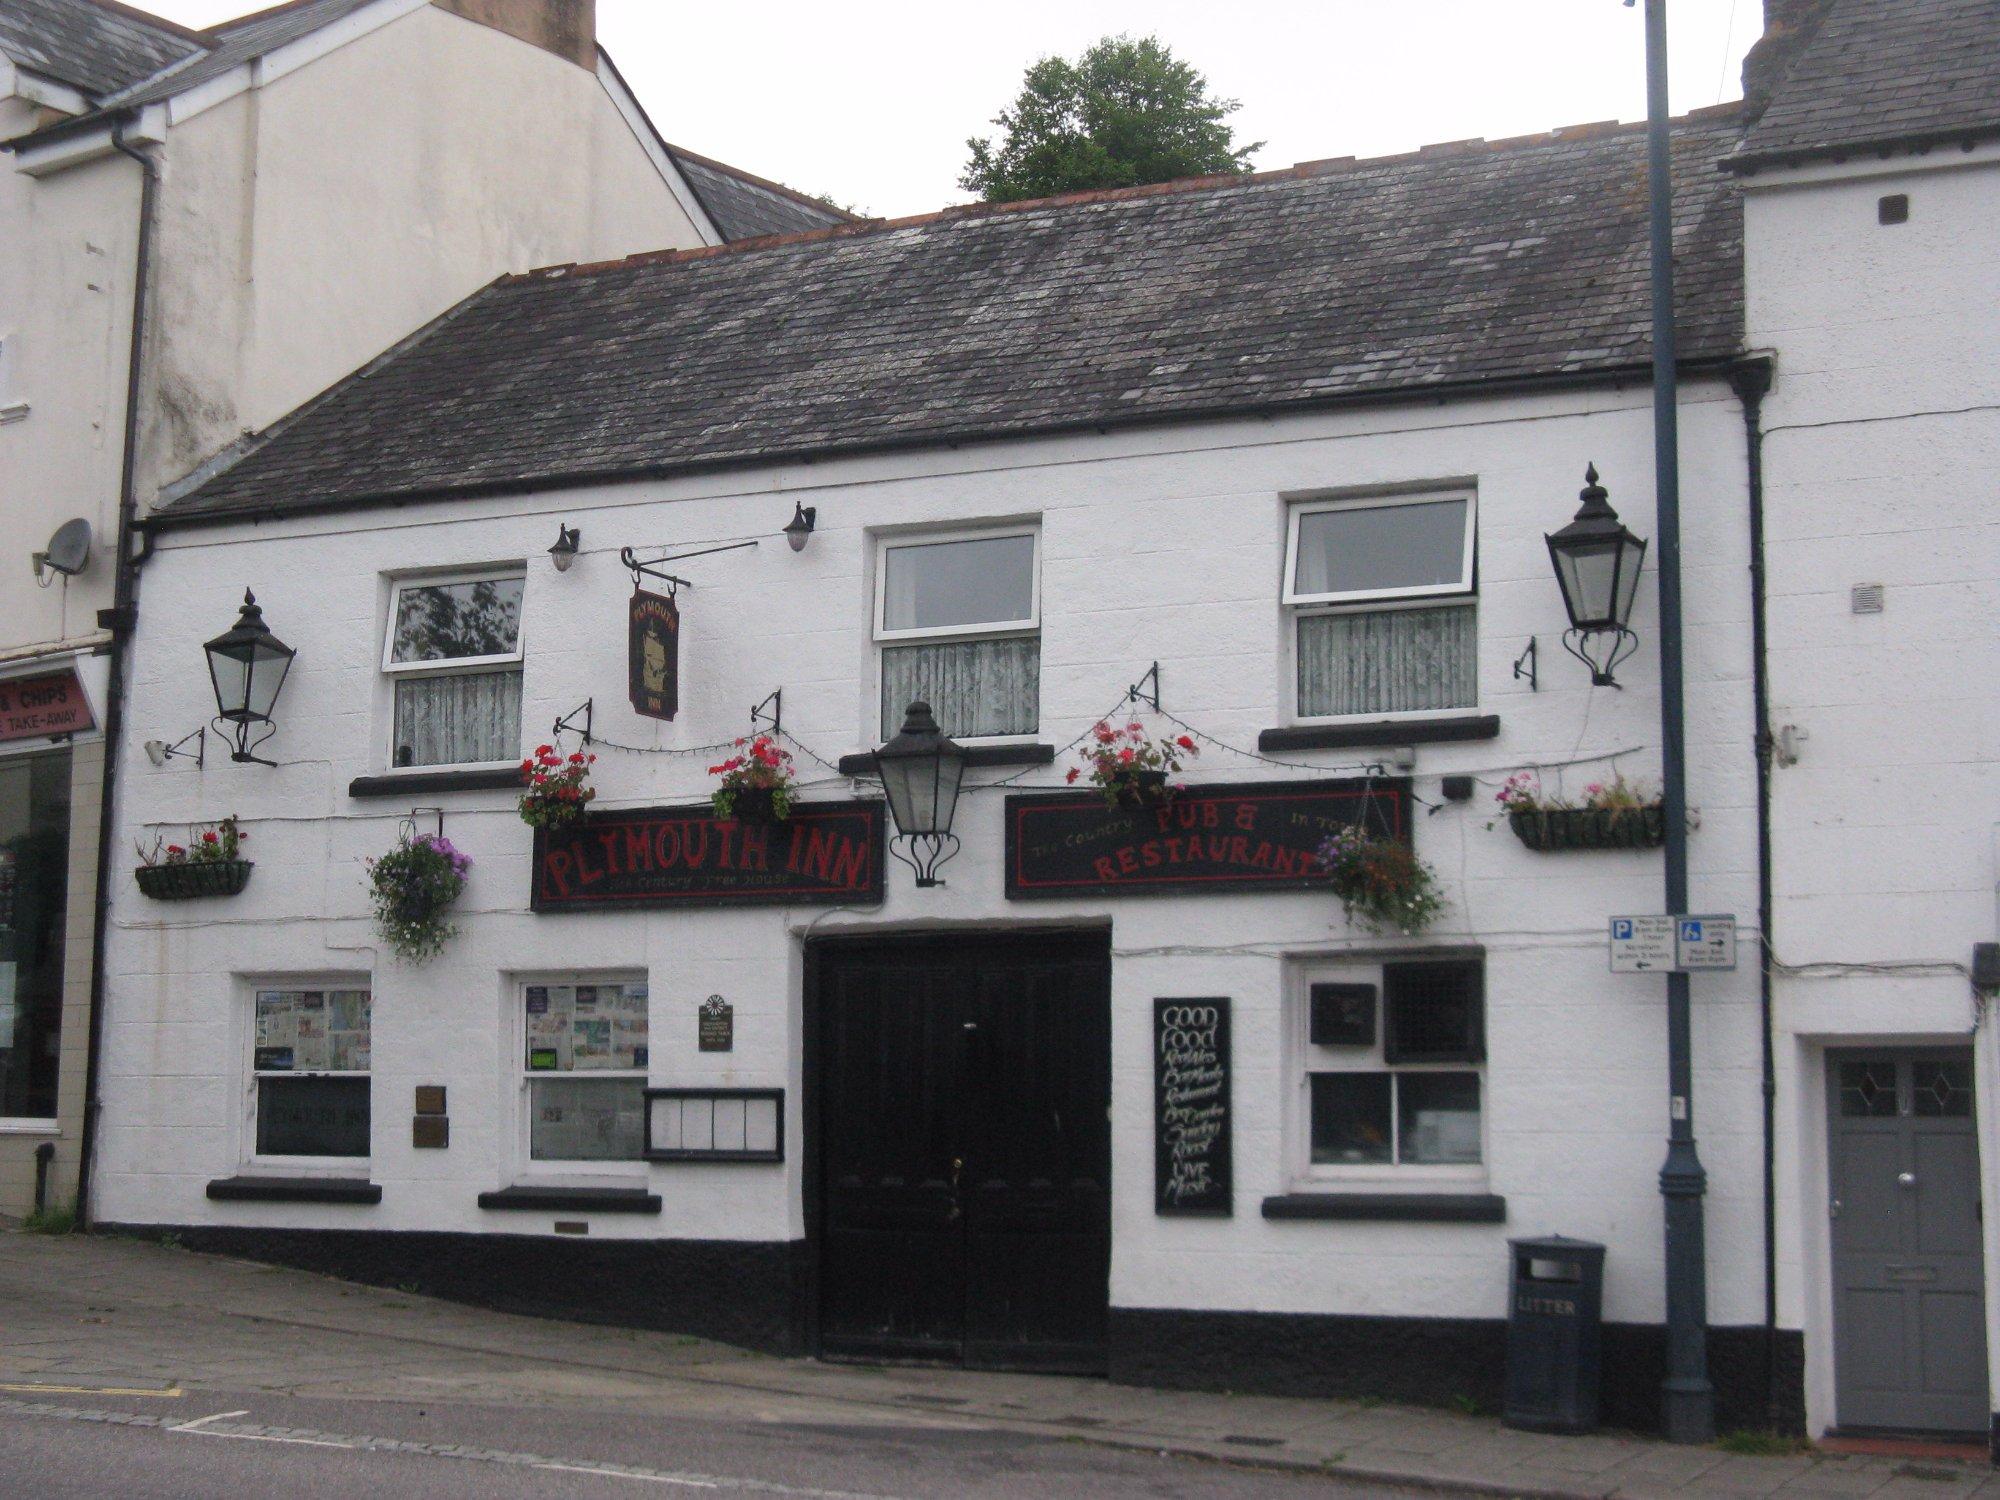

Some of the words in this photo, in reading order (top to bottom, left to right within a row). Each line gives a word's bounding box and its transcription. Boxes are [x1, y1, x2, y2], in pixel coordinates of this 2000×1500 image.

[20, 684, 67, 709] CHIPS
[647, 696, 661, 711] INN
[9, 709, 77, 731] TAKE-AWAY
[1157, 801, 1219, 833] PUB
[1235, 803, 1258, 831] &
[545, 817, 769, 898] PLYMOUTH
[786, 823, 867, 889] INN
[1093, 836, 1319, 880] RESTAURANT
